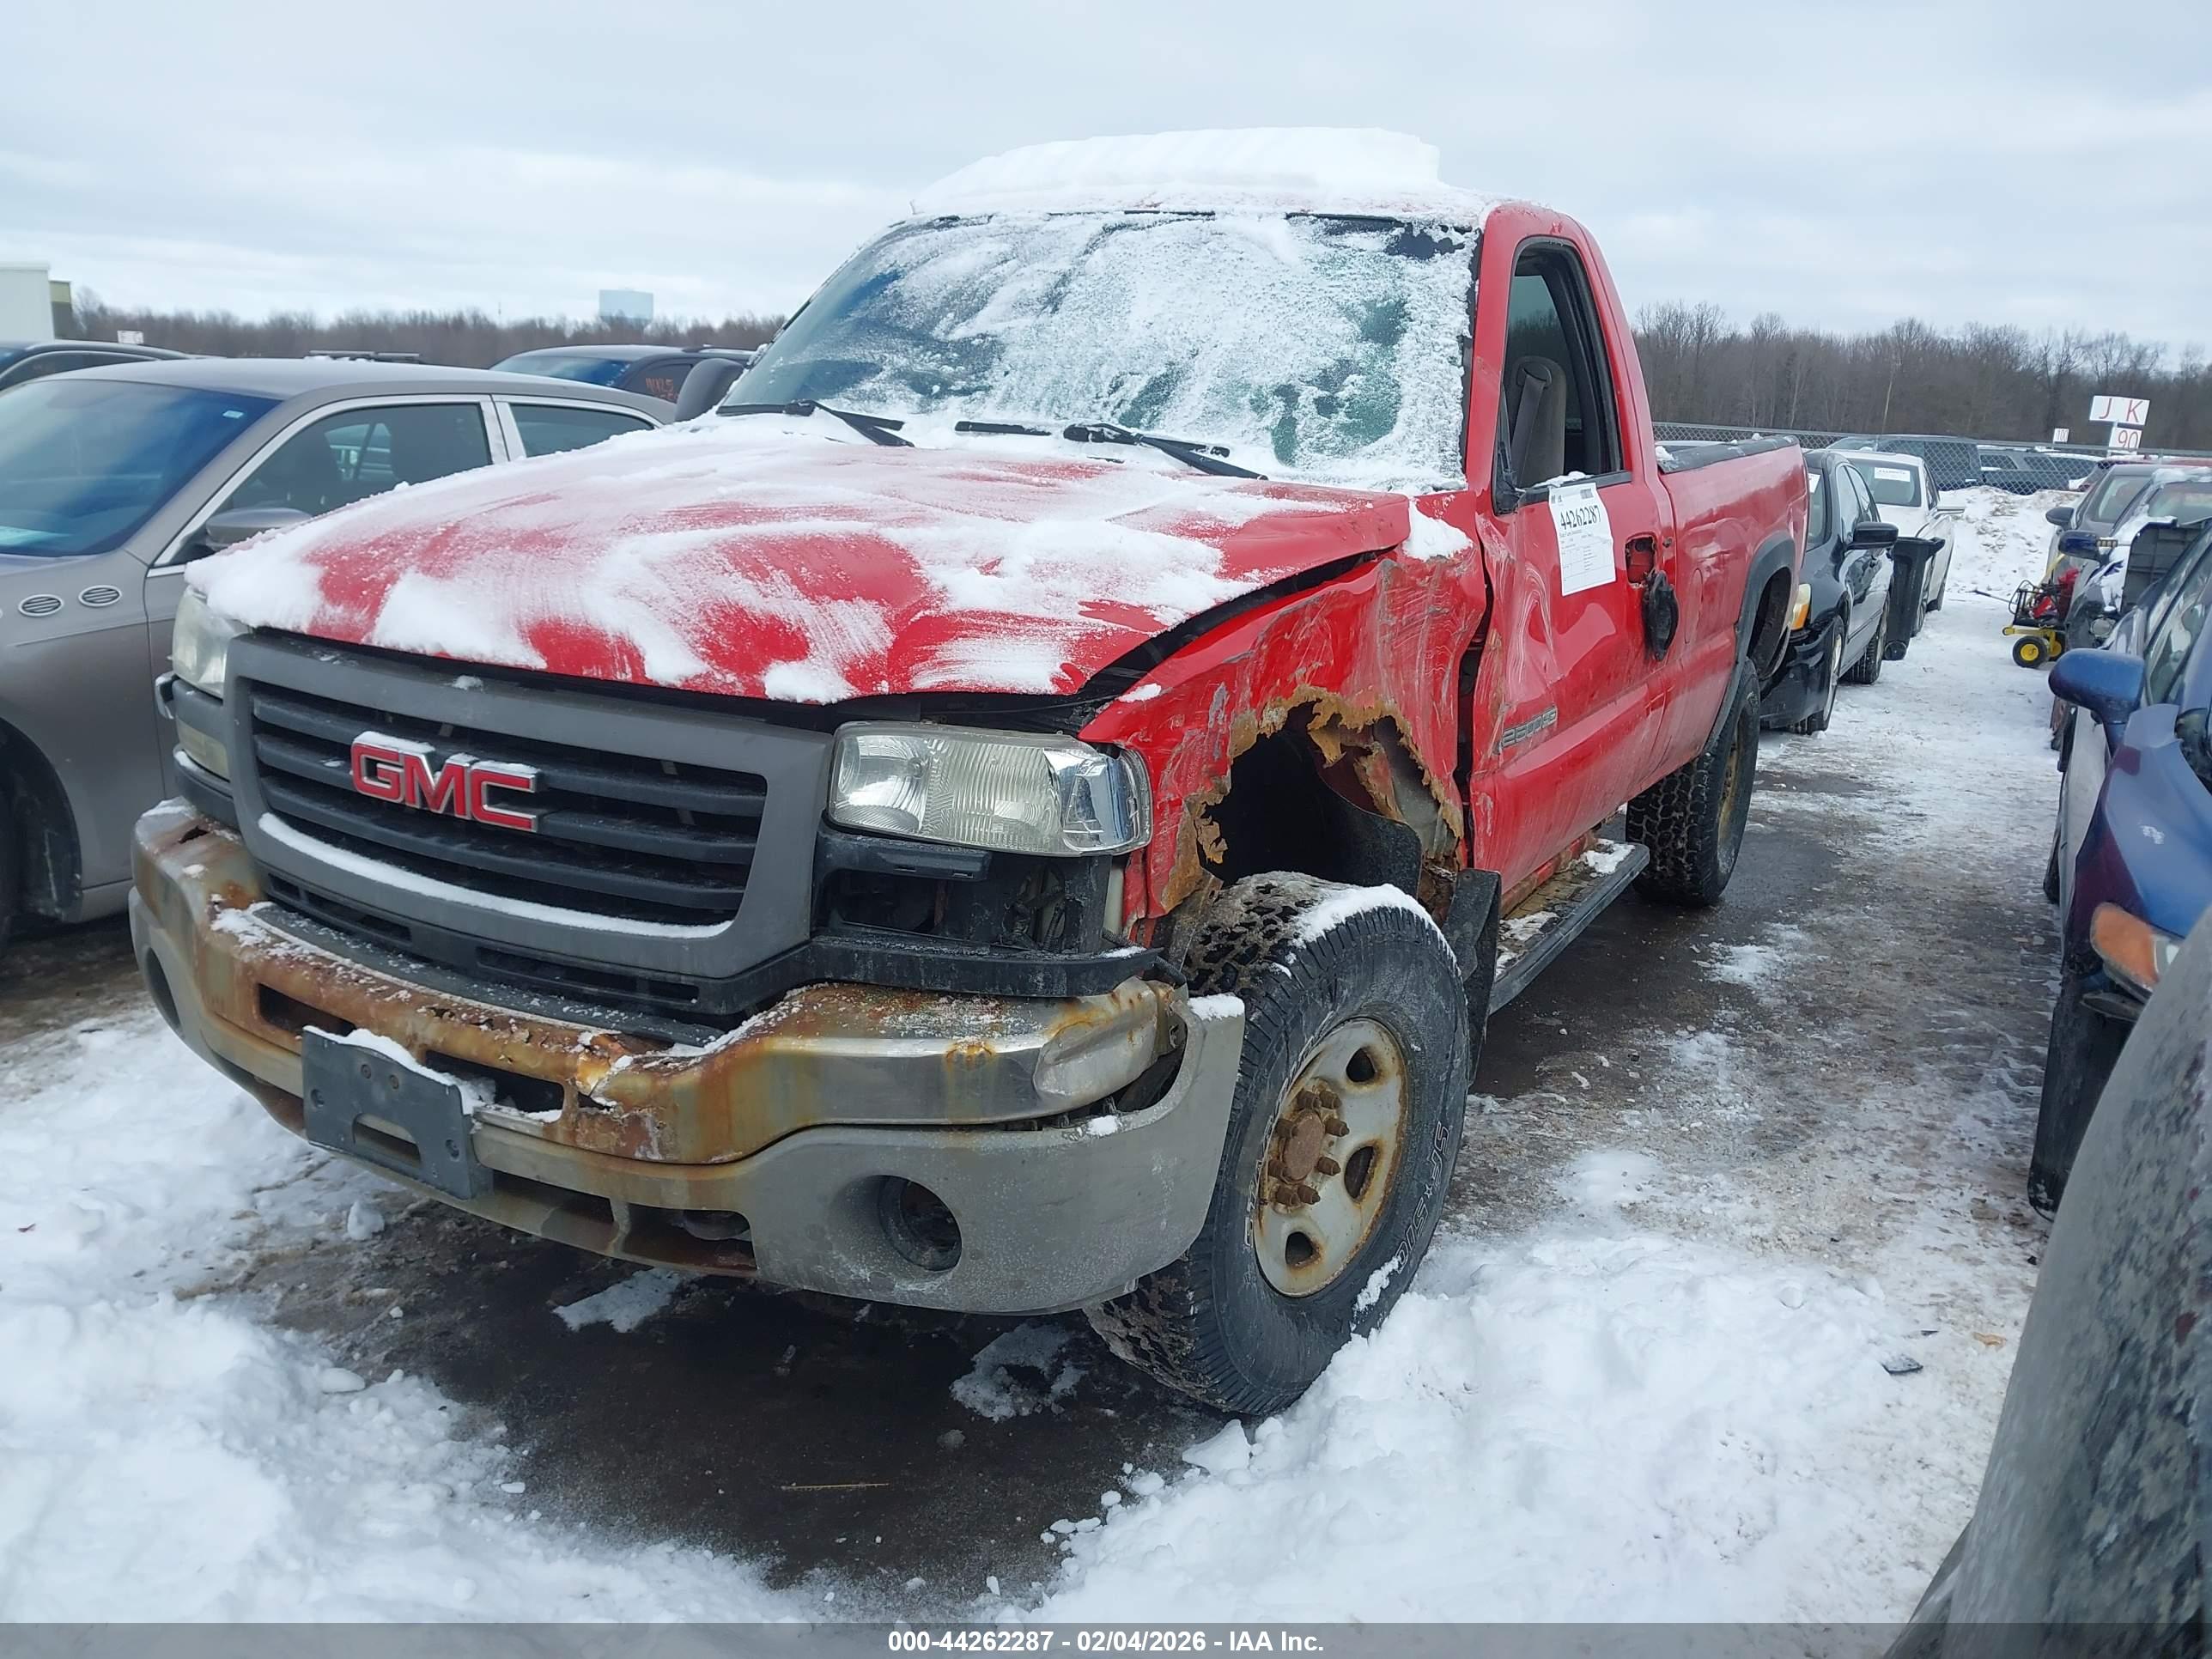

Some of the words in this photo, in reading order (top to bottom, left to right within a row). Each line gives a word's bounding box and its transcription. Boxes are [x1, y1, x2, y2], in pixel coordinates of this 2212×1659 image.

[2099, 398, 2112, 420] J
[2126, 400, 2143, 423] K
[2118, 430, 2139, 452] 90
[1560, 504, 1601, 531] 44262287
[350, 740, 538, 833] GMC
